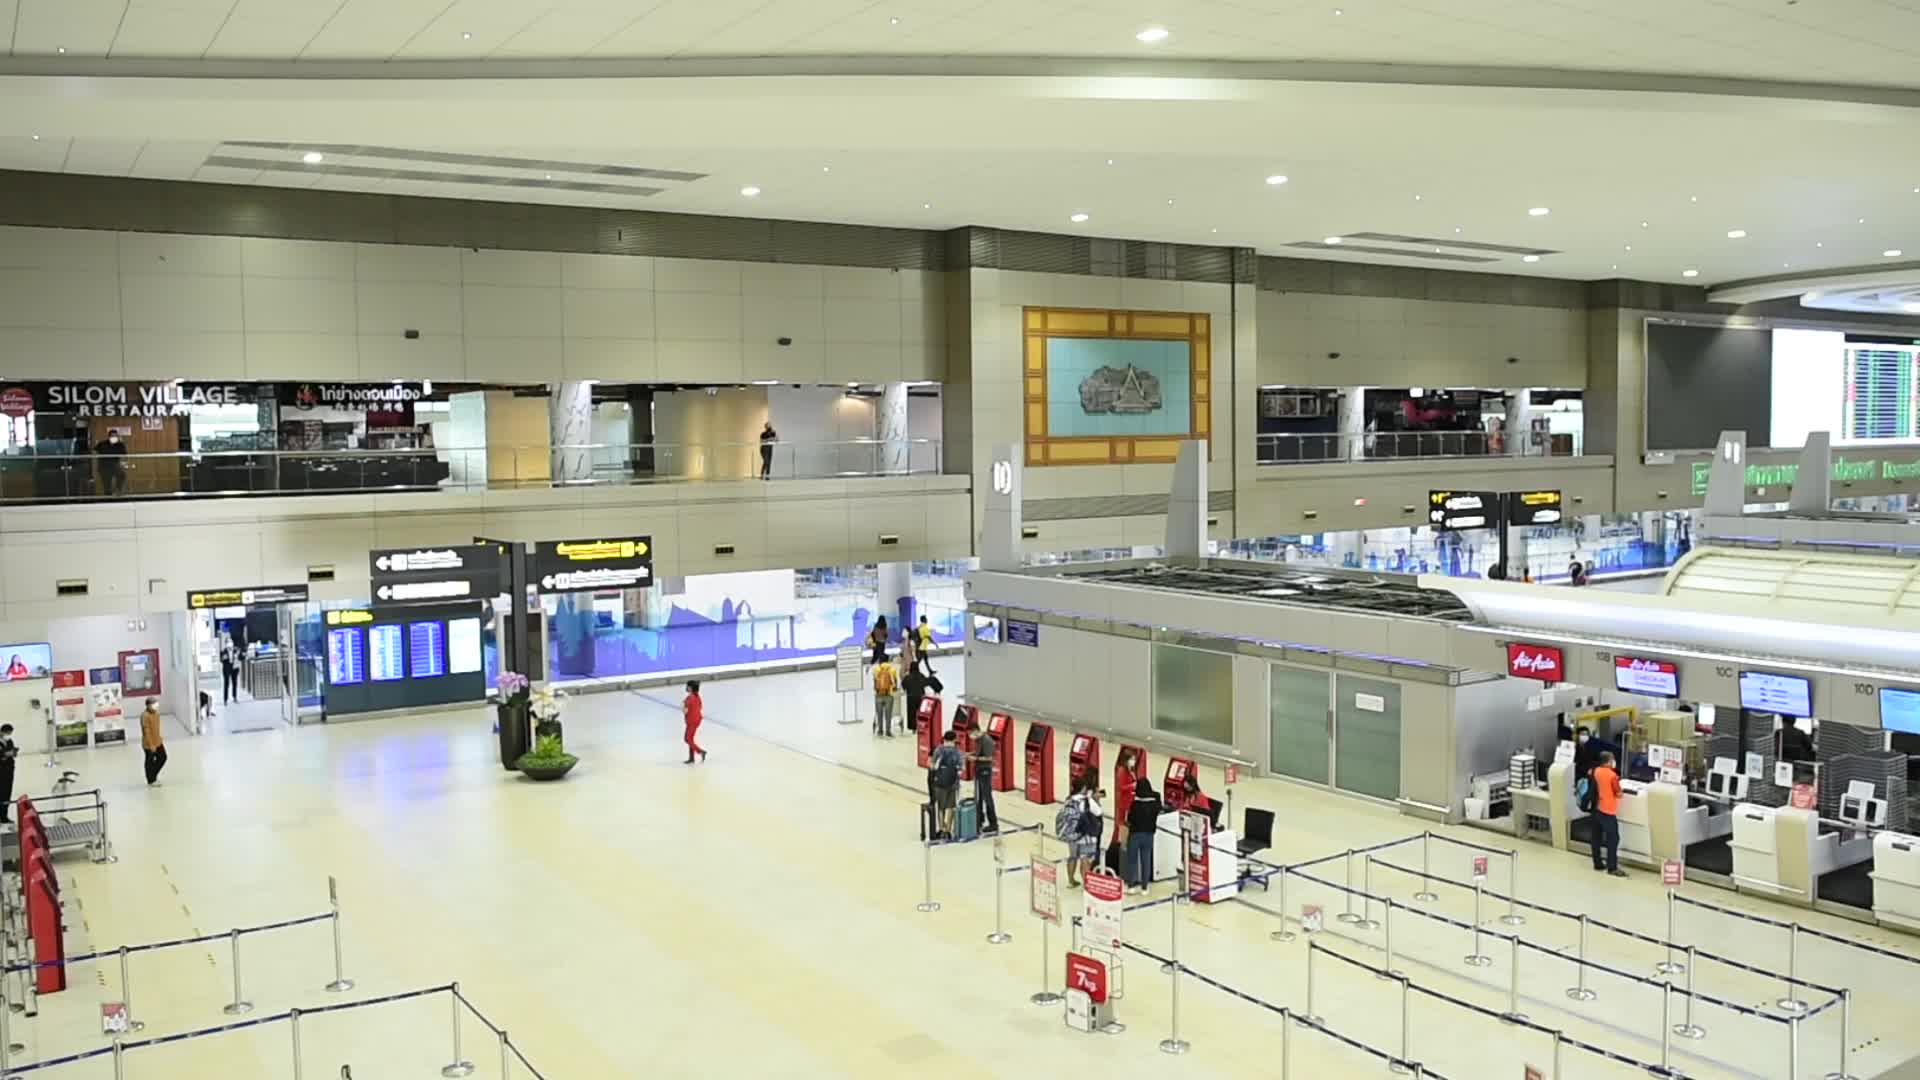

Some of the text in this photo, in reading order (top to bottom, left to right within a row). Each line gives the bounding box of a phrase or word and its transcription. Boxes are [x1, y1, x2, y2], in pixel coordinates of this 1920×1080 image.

[48, 386, 238, 404] SILOM VILLAGE
[318, 385, 421, 401] ไก่ย่างดอนเมือง
[1716, 666, 1733, 678] 10C
[1854, 683, 1874, 695] 10D
